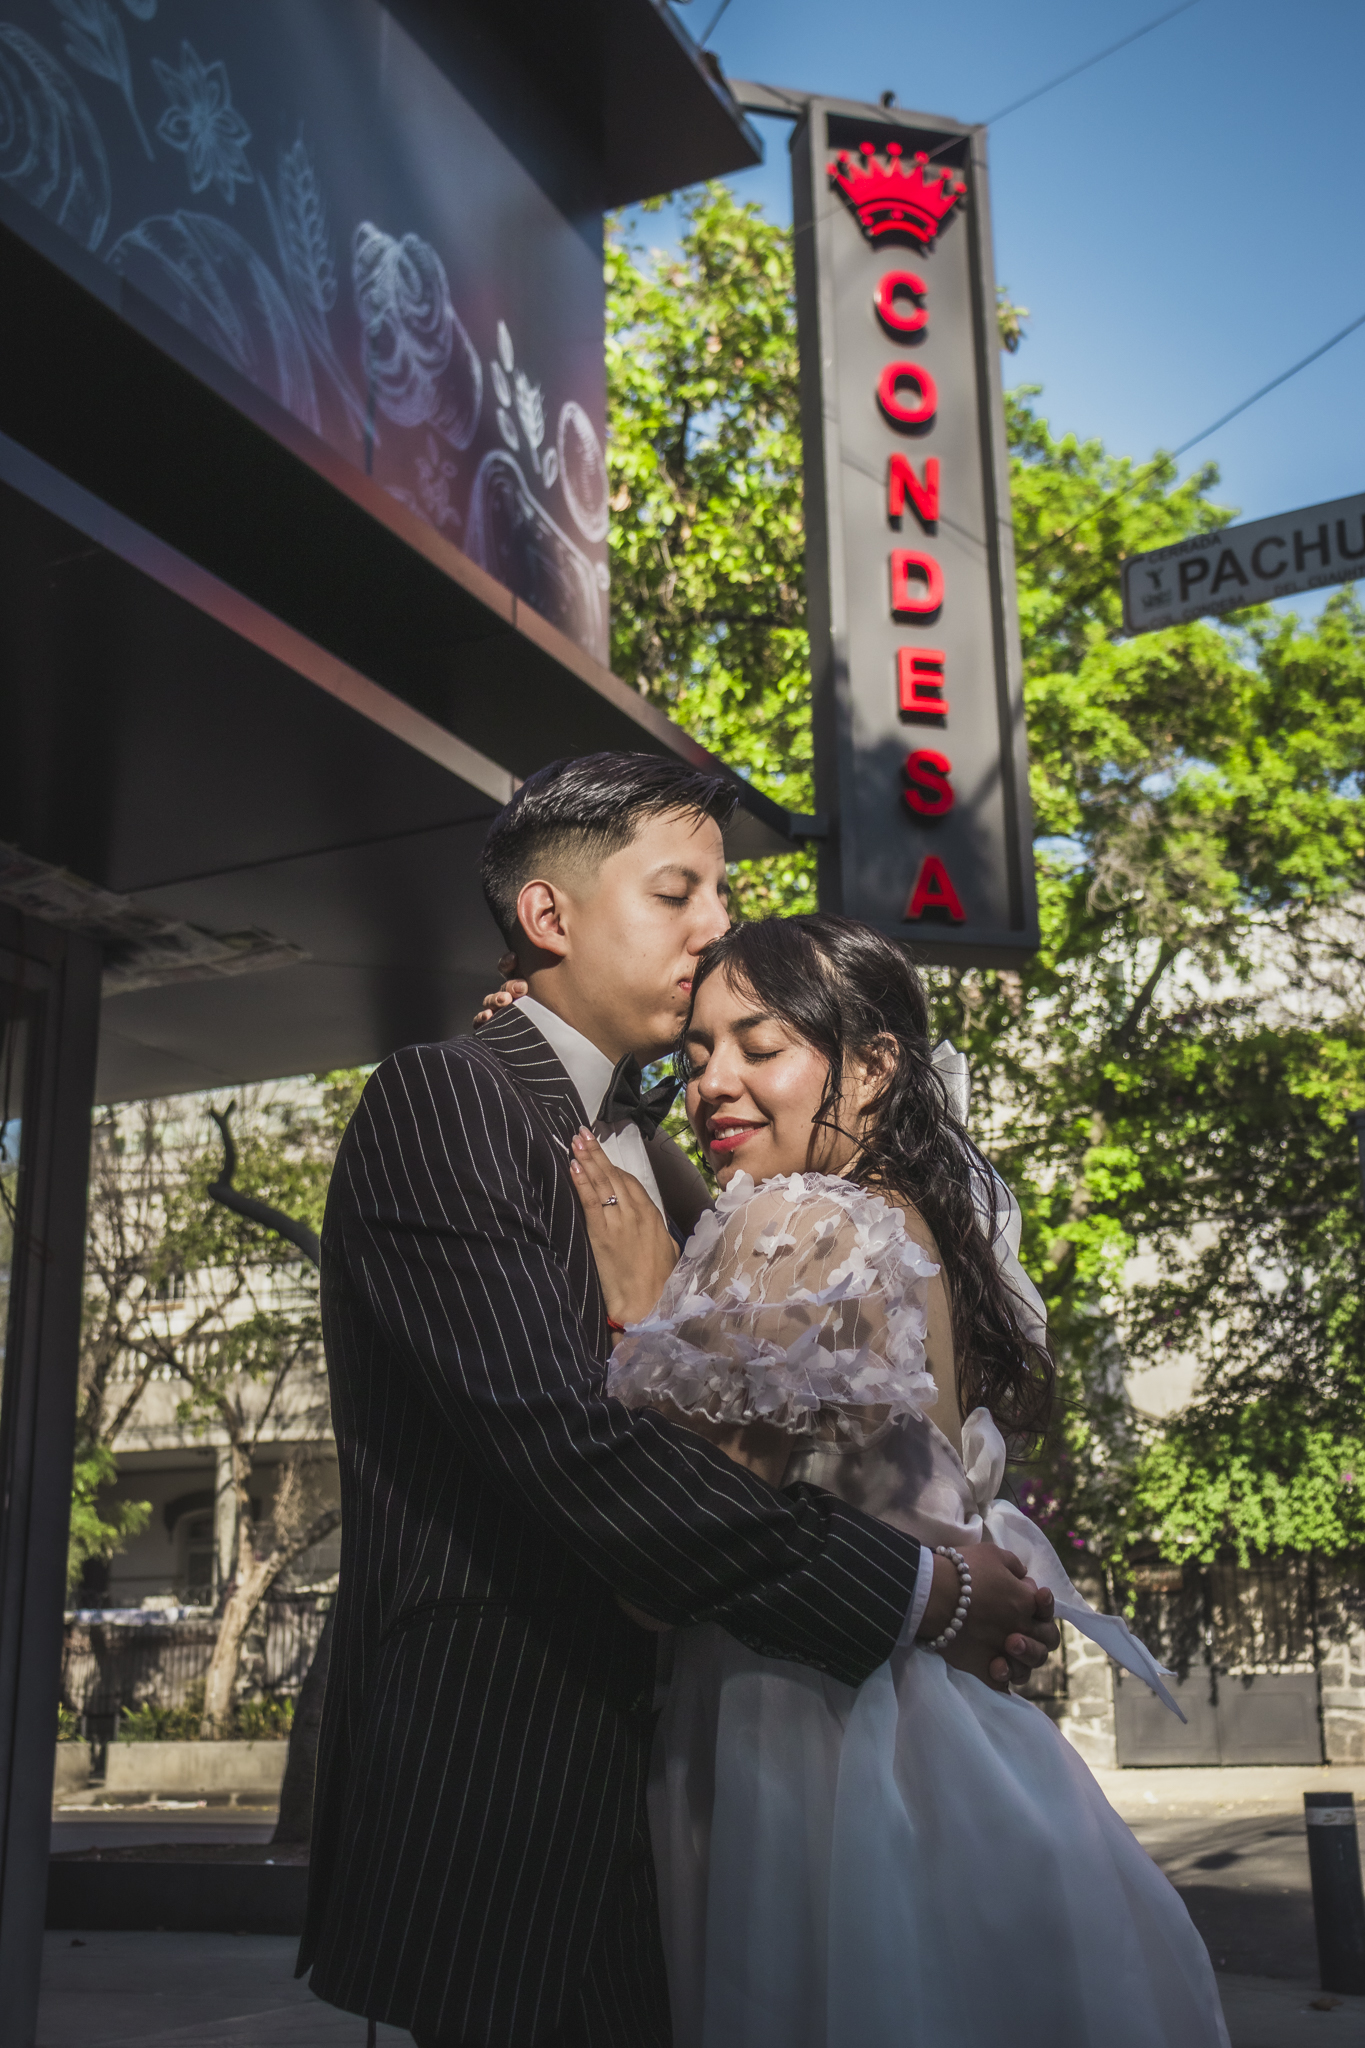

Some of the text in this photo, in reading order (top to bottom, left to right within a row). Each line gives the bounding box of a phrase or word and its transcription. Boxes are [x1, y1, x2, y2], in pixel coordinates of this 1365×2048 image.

[1148, 534, 1222, 564] CERRADA
[876, 269, 964, 919] CONDESA
[1182, 594, 1246, 623] CONDESA
